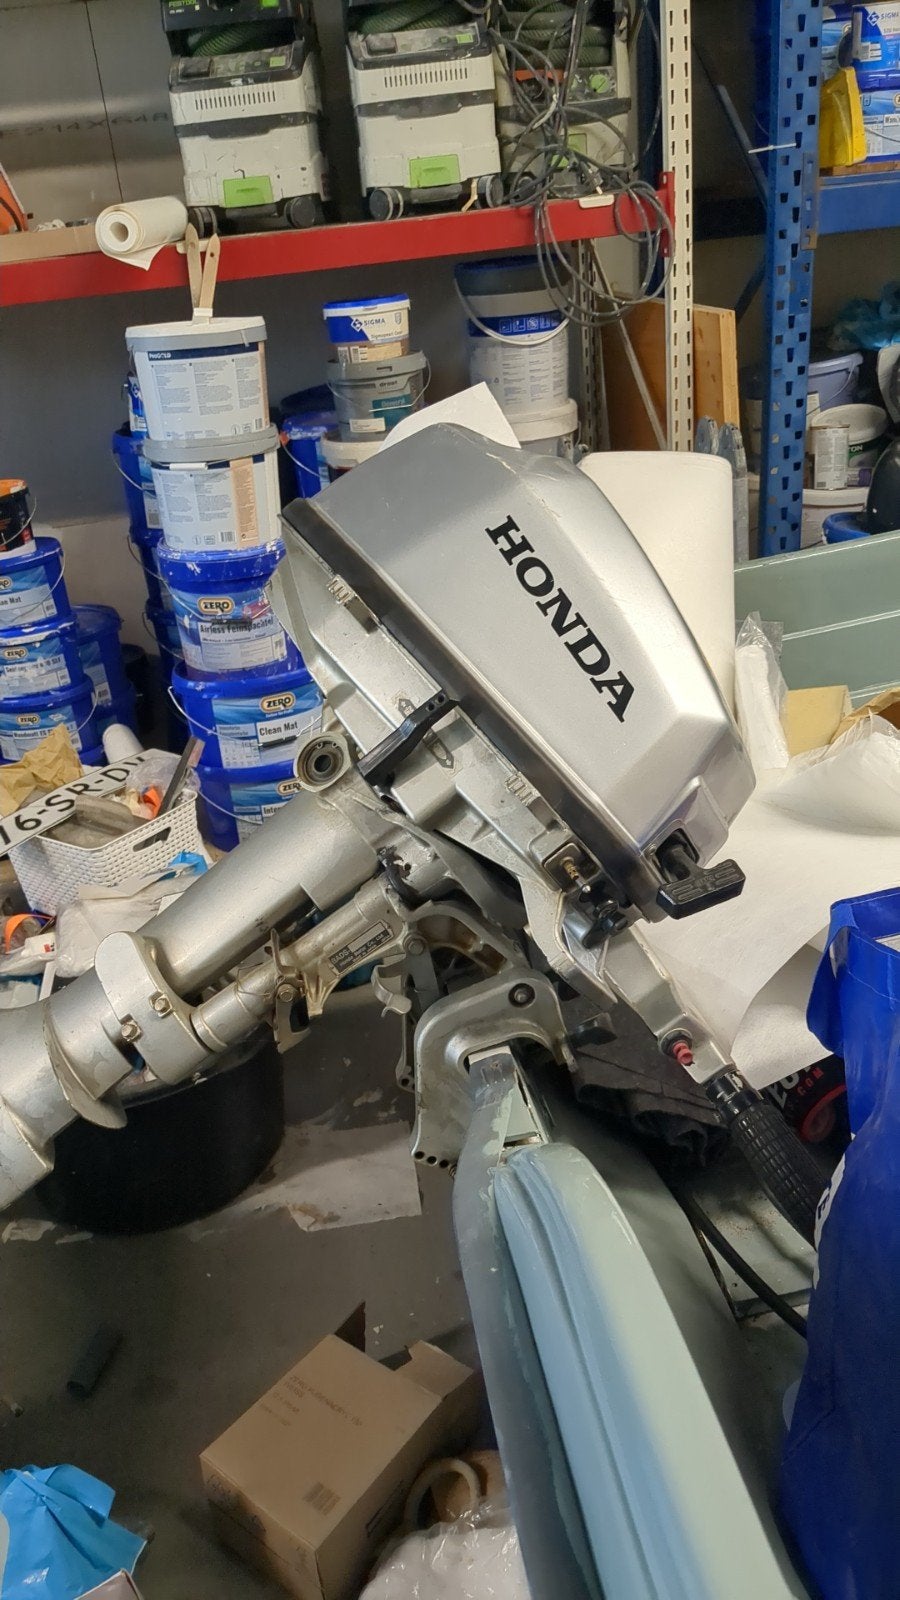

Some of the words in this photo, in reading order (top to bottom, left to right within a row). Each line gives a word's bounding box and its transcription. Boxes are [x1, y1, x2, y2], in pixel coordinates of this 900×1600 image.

[881, 11, 900, 20] SIGM
[364, 317, 385, 326] SIGMA
[203, 601, 230, 613] ZERO
[485, 515, 635, 723] HONDA
[266, 696, 292, 710] ZERO
[259, 723, 283, 737] Clean
[284, 721, 299, 732] Mat
[282, 782, 301, 792] ZER
